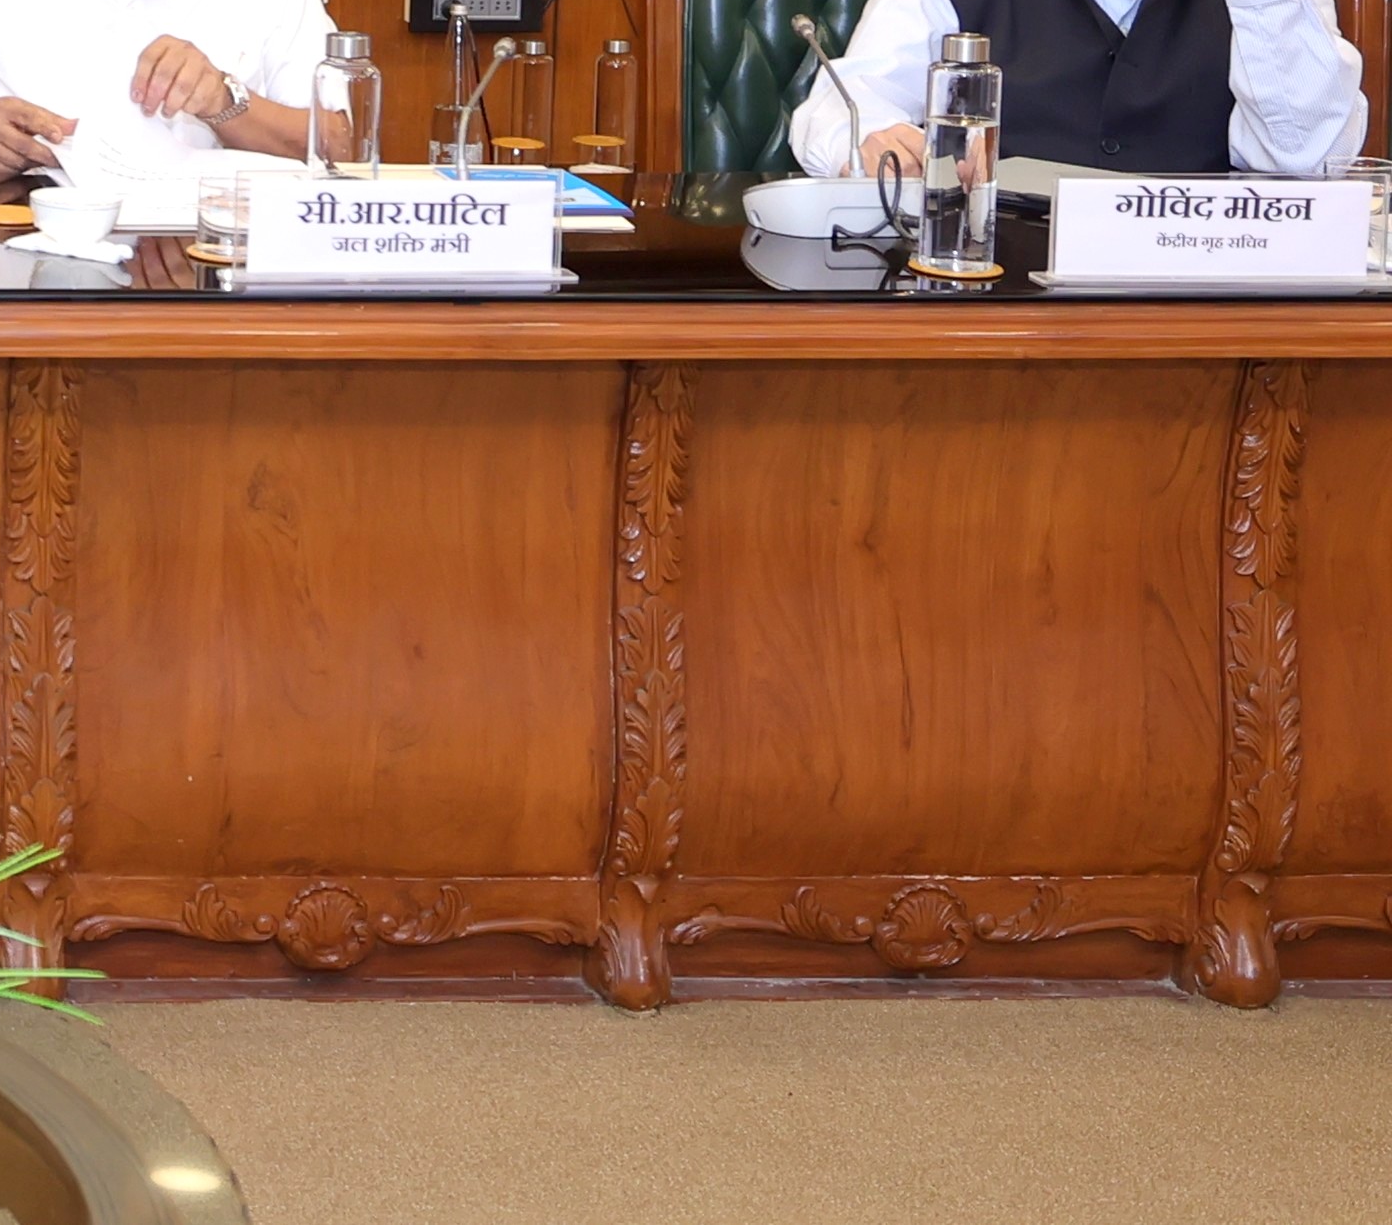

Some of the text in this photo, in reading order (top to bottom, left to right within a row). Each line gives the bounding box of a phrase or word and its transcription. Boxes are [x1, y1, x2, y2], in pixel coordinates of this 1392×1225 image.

[297, 192, 510, 226] सी.आर.पाटिल
[1115, 185, 1317, 223] गोविंद मोहन
[332, 232, 472, 254] जल शक्ति मंत्री
[1200, 236, 1224, 253] गृह
[1227, 234, 1269, 249] सचिव
